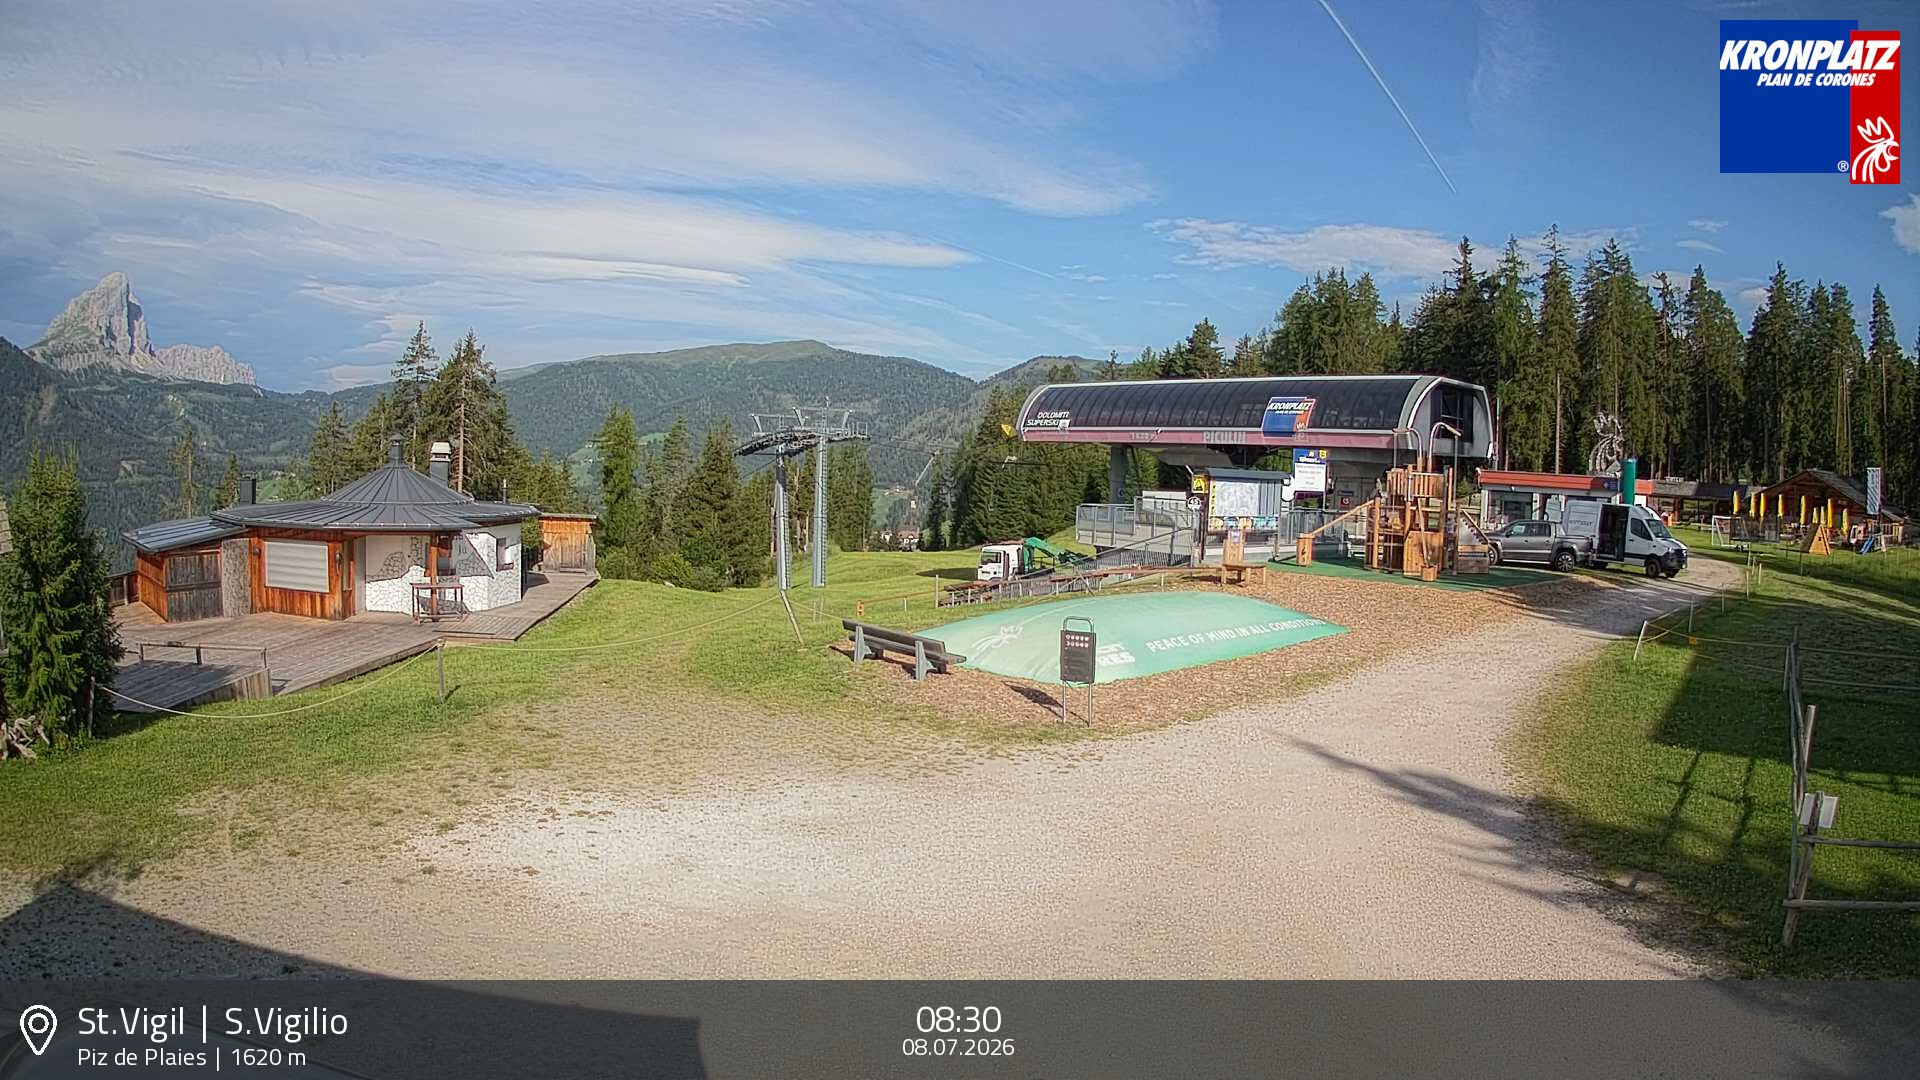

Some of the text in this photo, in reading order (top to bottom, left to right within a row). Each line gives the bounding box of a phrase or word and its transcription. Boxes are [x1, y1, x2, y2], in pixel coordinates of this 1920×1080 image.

[1037, 411, 1070, 419] DOLOMITI
[1145, 635, 1190, 652] PEACE
[1188, 633, 1205, 644] OF
[1206, 629, 1236, 641] MIND
[1235, 627, 1250, 639] IN
[1249, 624, 1271, 634] ALL
